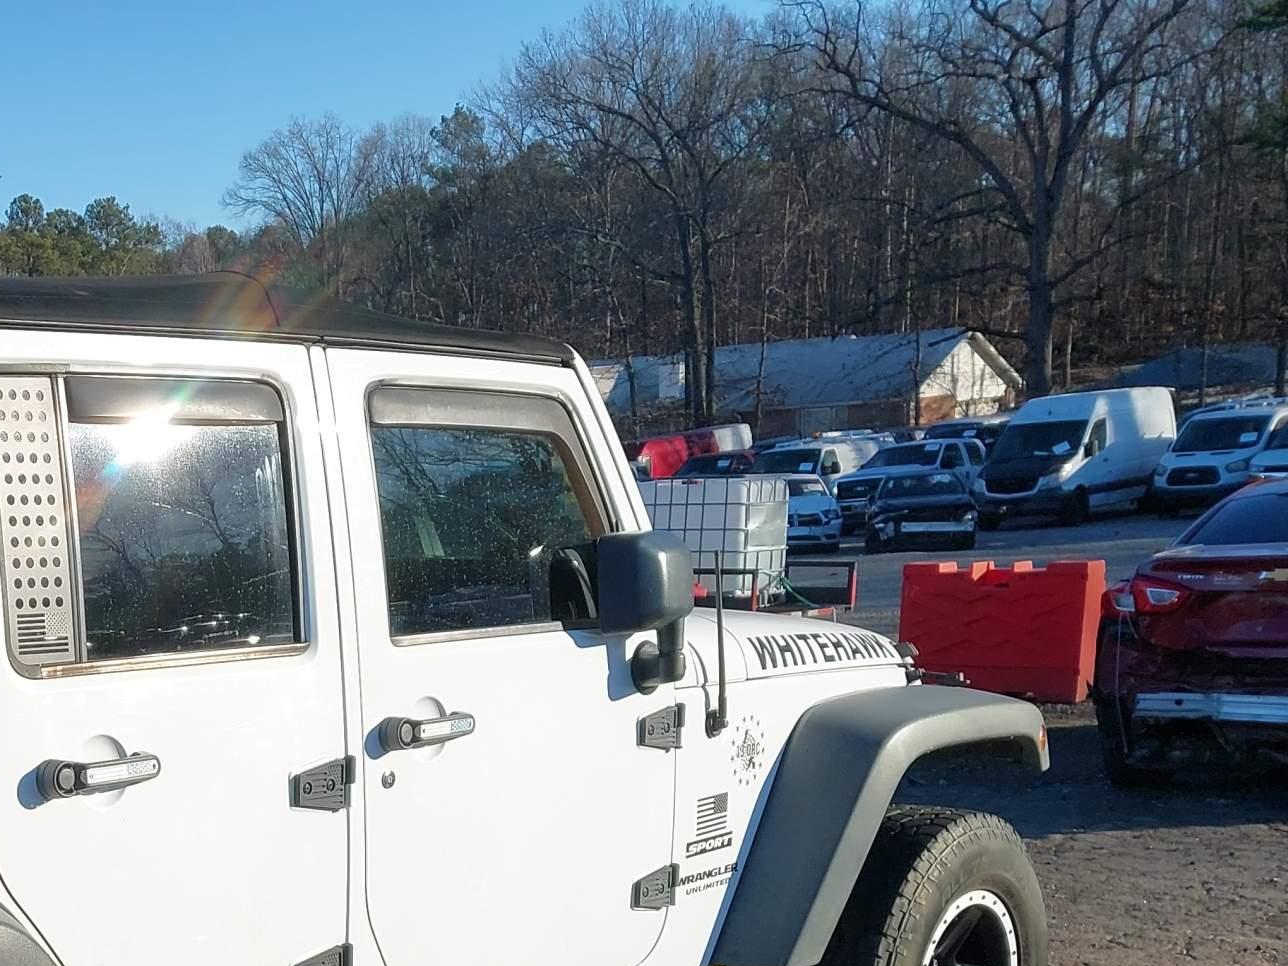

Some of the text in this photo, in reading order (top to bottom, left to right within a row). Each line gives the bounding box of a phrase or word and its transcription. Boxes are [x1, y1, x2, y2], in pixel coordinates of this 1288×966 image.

[747, 633, 895, 670] WHITEHAWK
[688, 837, 730, 855] SPORT
[678, 862, 738, 886] WRANGLER
